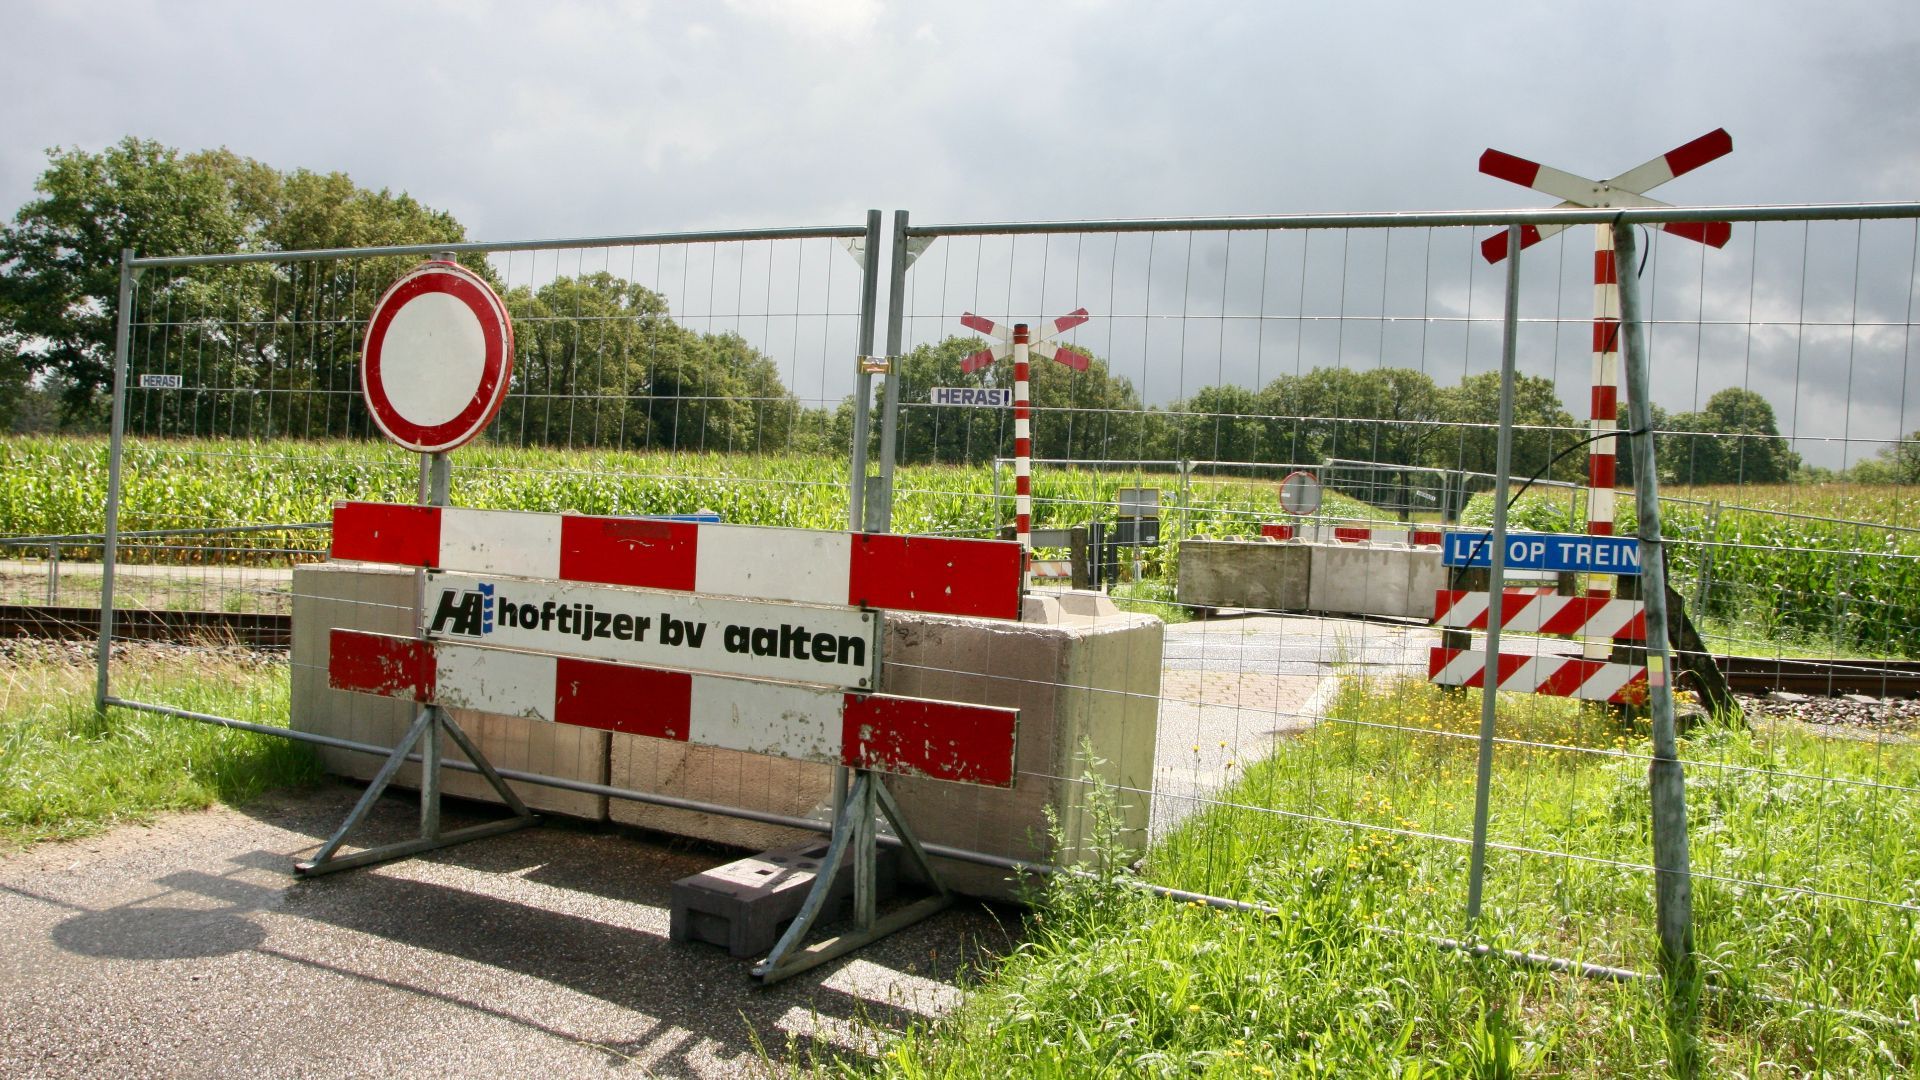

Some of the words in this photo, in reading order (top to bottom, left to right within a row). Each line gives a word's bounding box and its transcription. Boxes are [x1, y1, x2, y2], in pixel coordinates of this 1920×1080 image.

[1509, 541, 1545, 563] OP
[1559, 543, 1641, 567] TREIN
[498, 597, 650, 641] hoftijzer
[659, 613, 706, 649] bv
[724, 624, 866, 667] aalten
